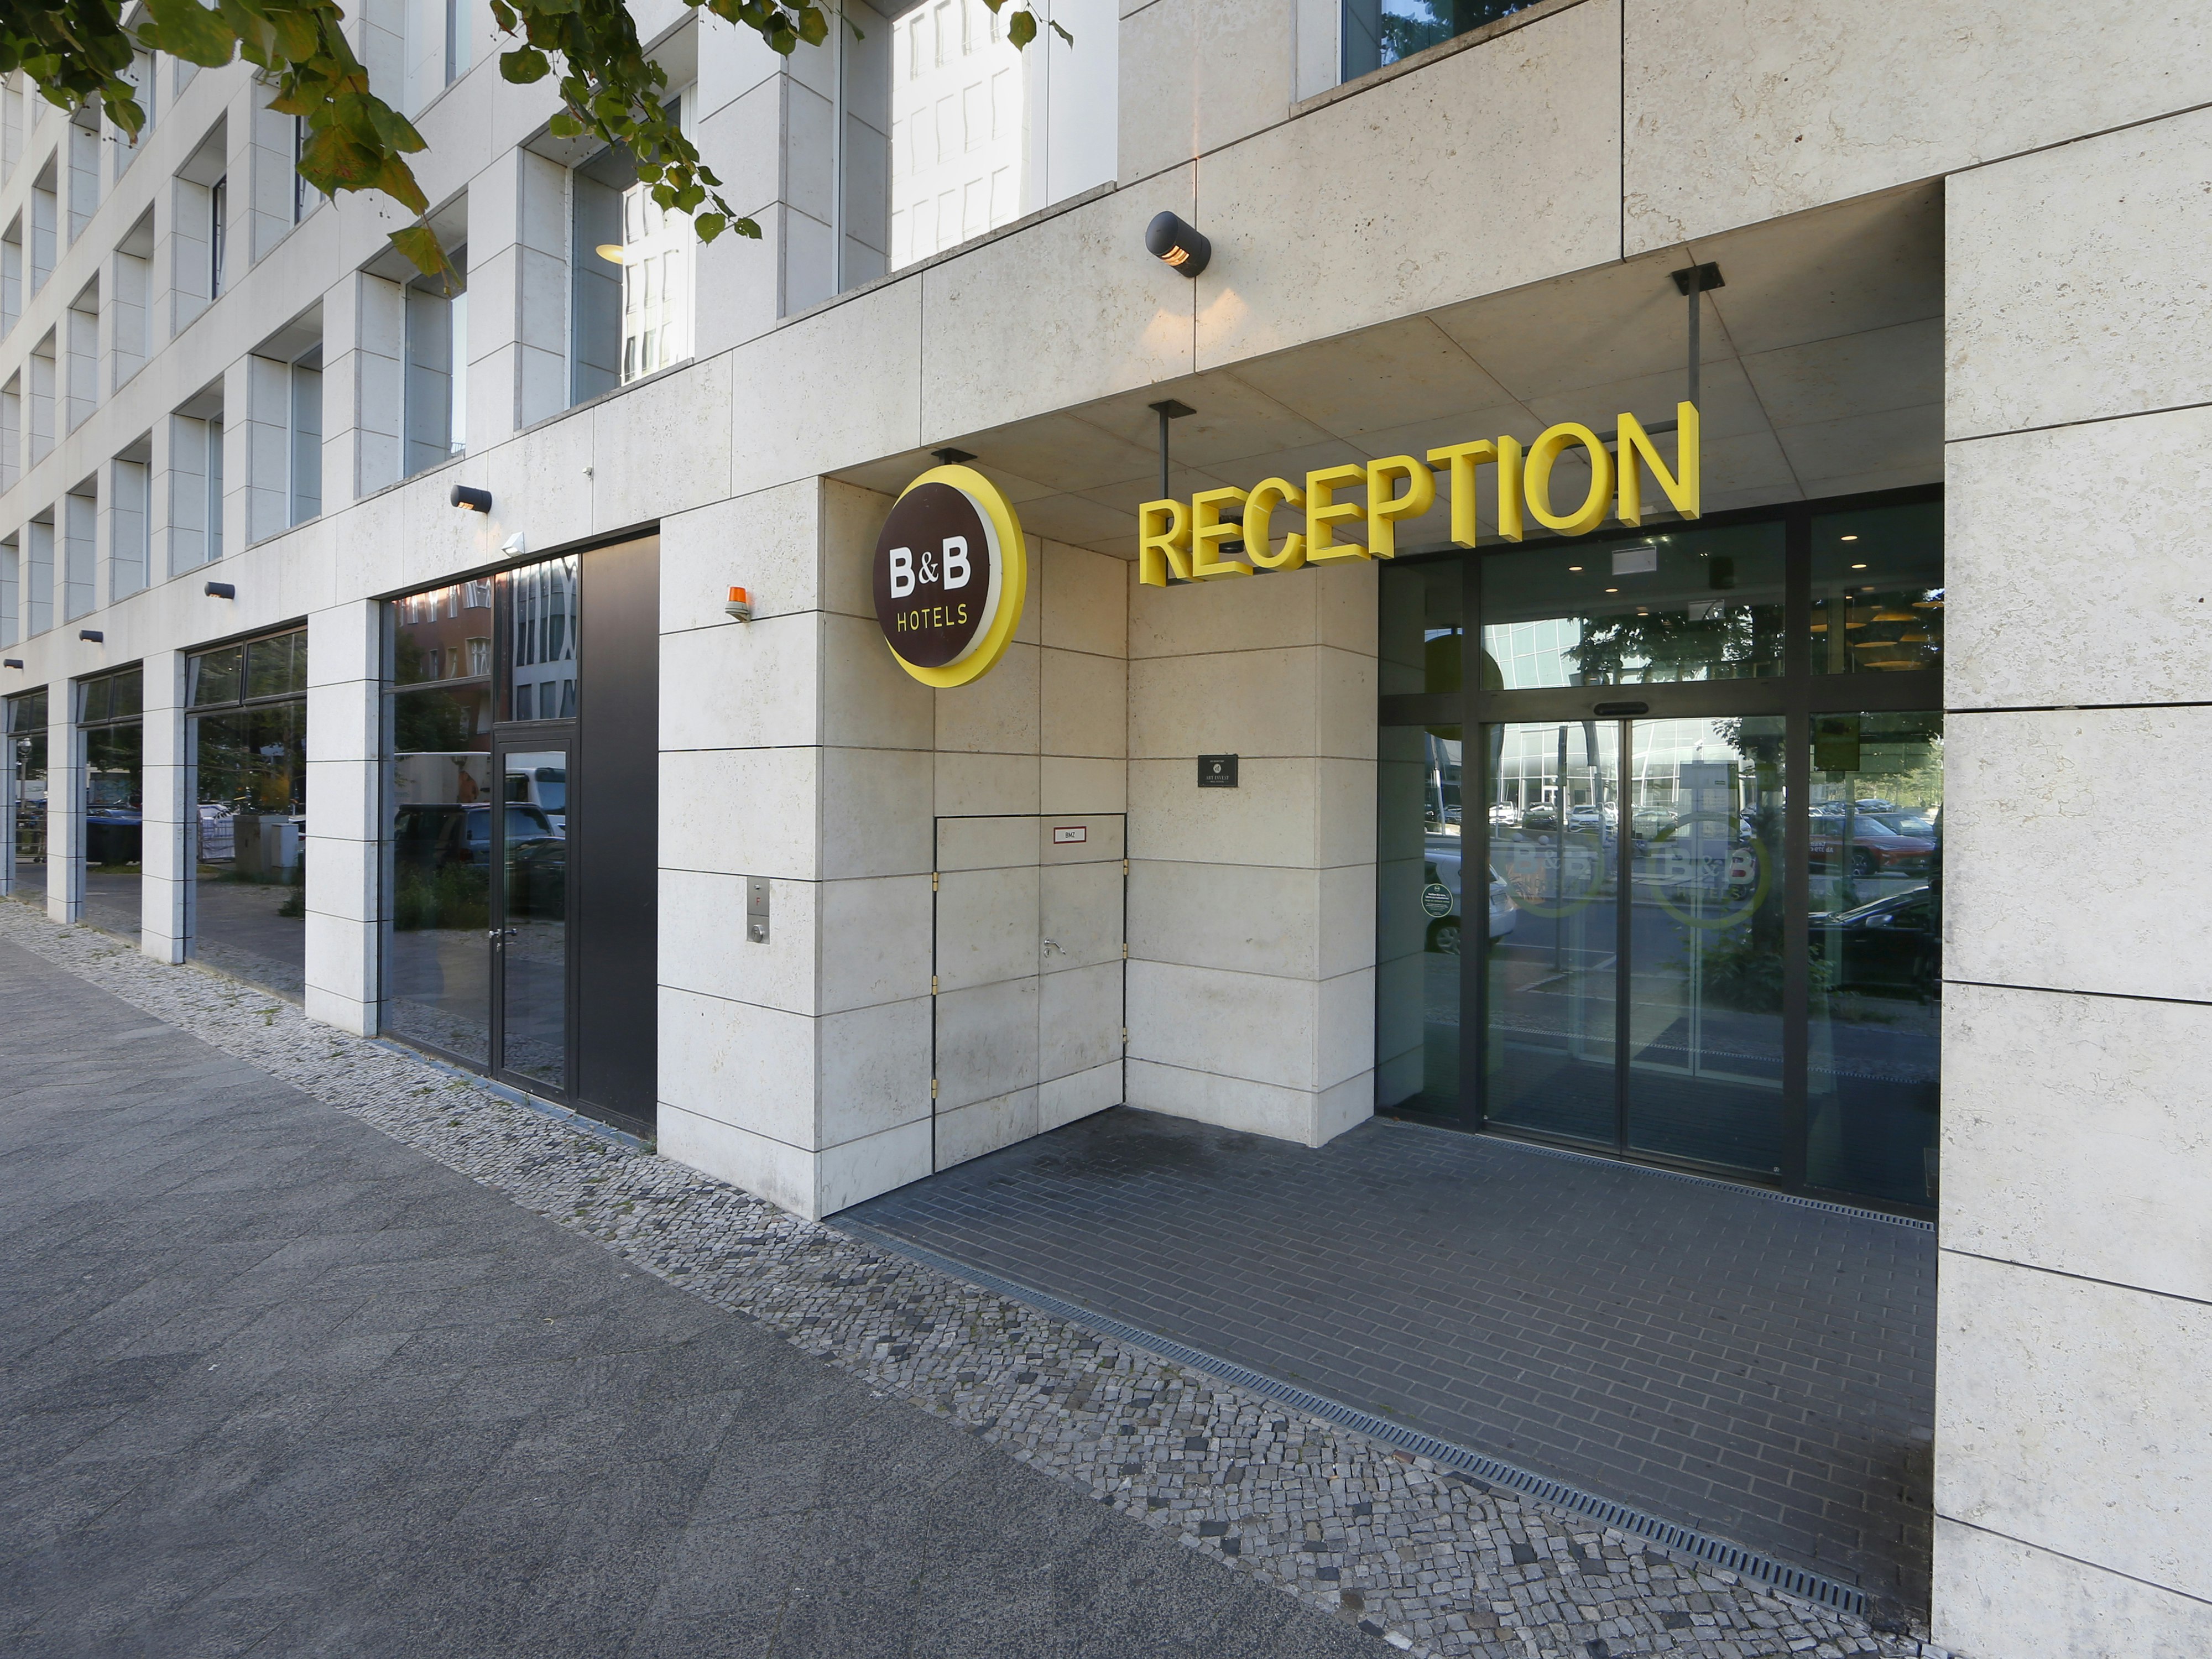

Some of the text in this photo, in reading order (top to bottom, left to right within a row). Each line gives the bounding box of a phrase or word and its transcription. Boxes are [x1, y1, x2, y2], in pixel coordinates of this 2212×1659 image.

[1139, 400, 1700, 587] RECEPTION
[889, 535, 971, 599] B&B
[897, 603, 967, 632] HOTELS
[1514, 843, 1591, 876] B&B
[1665, 848, 1755, 884] B&B
[757, 897, 760, 906] F
